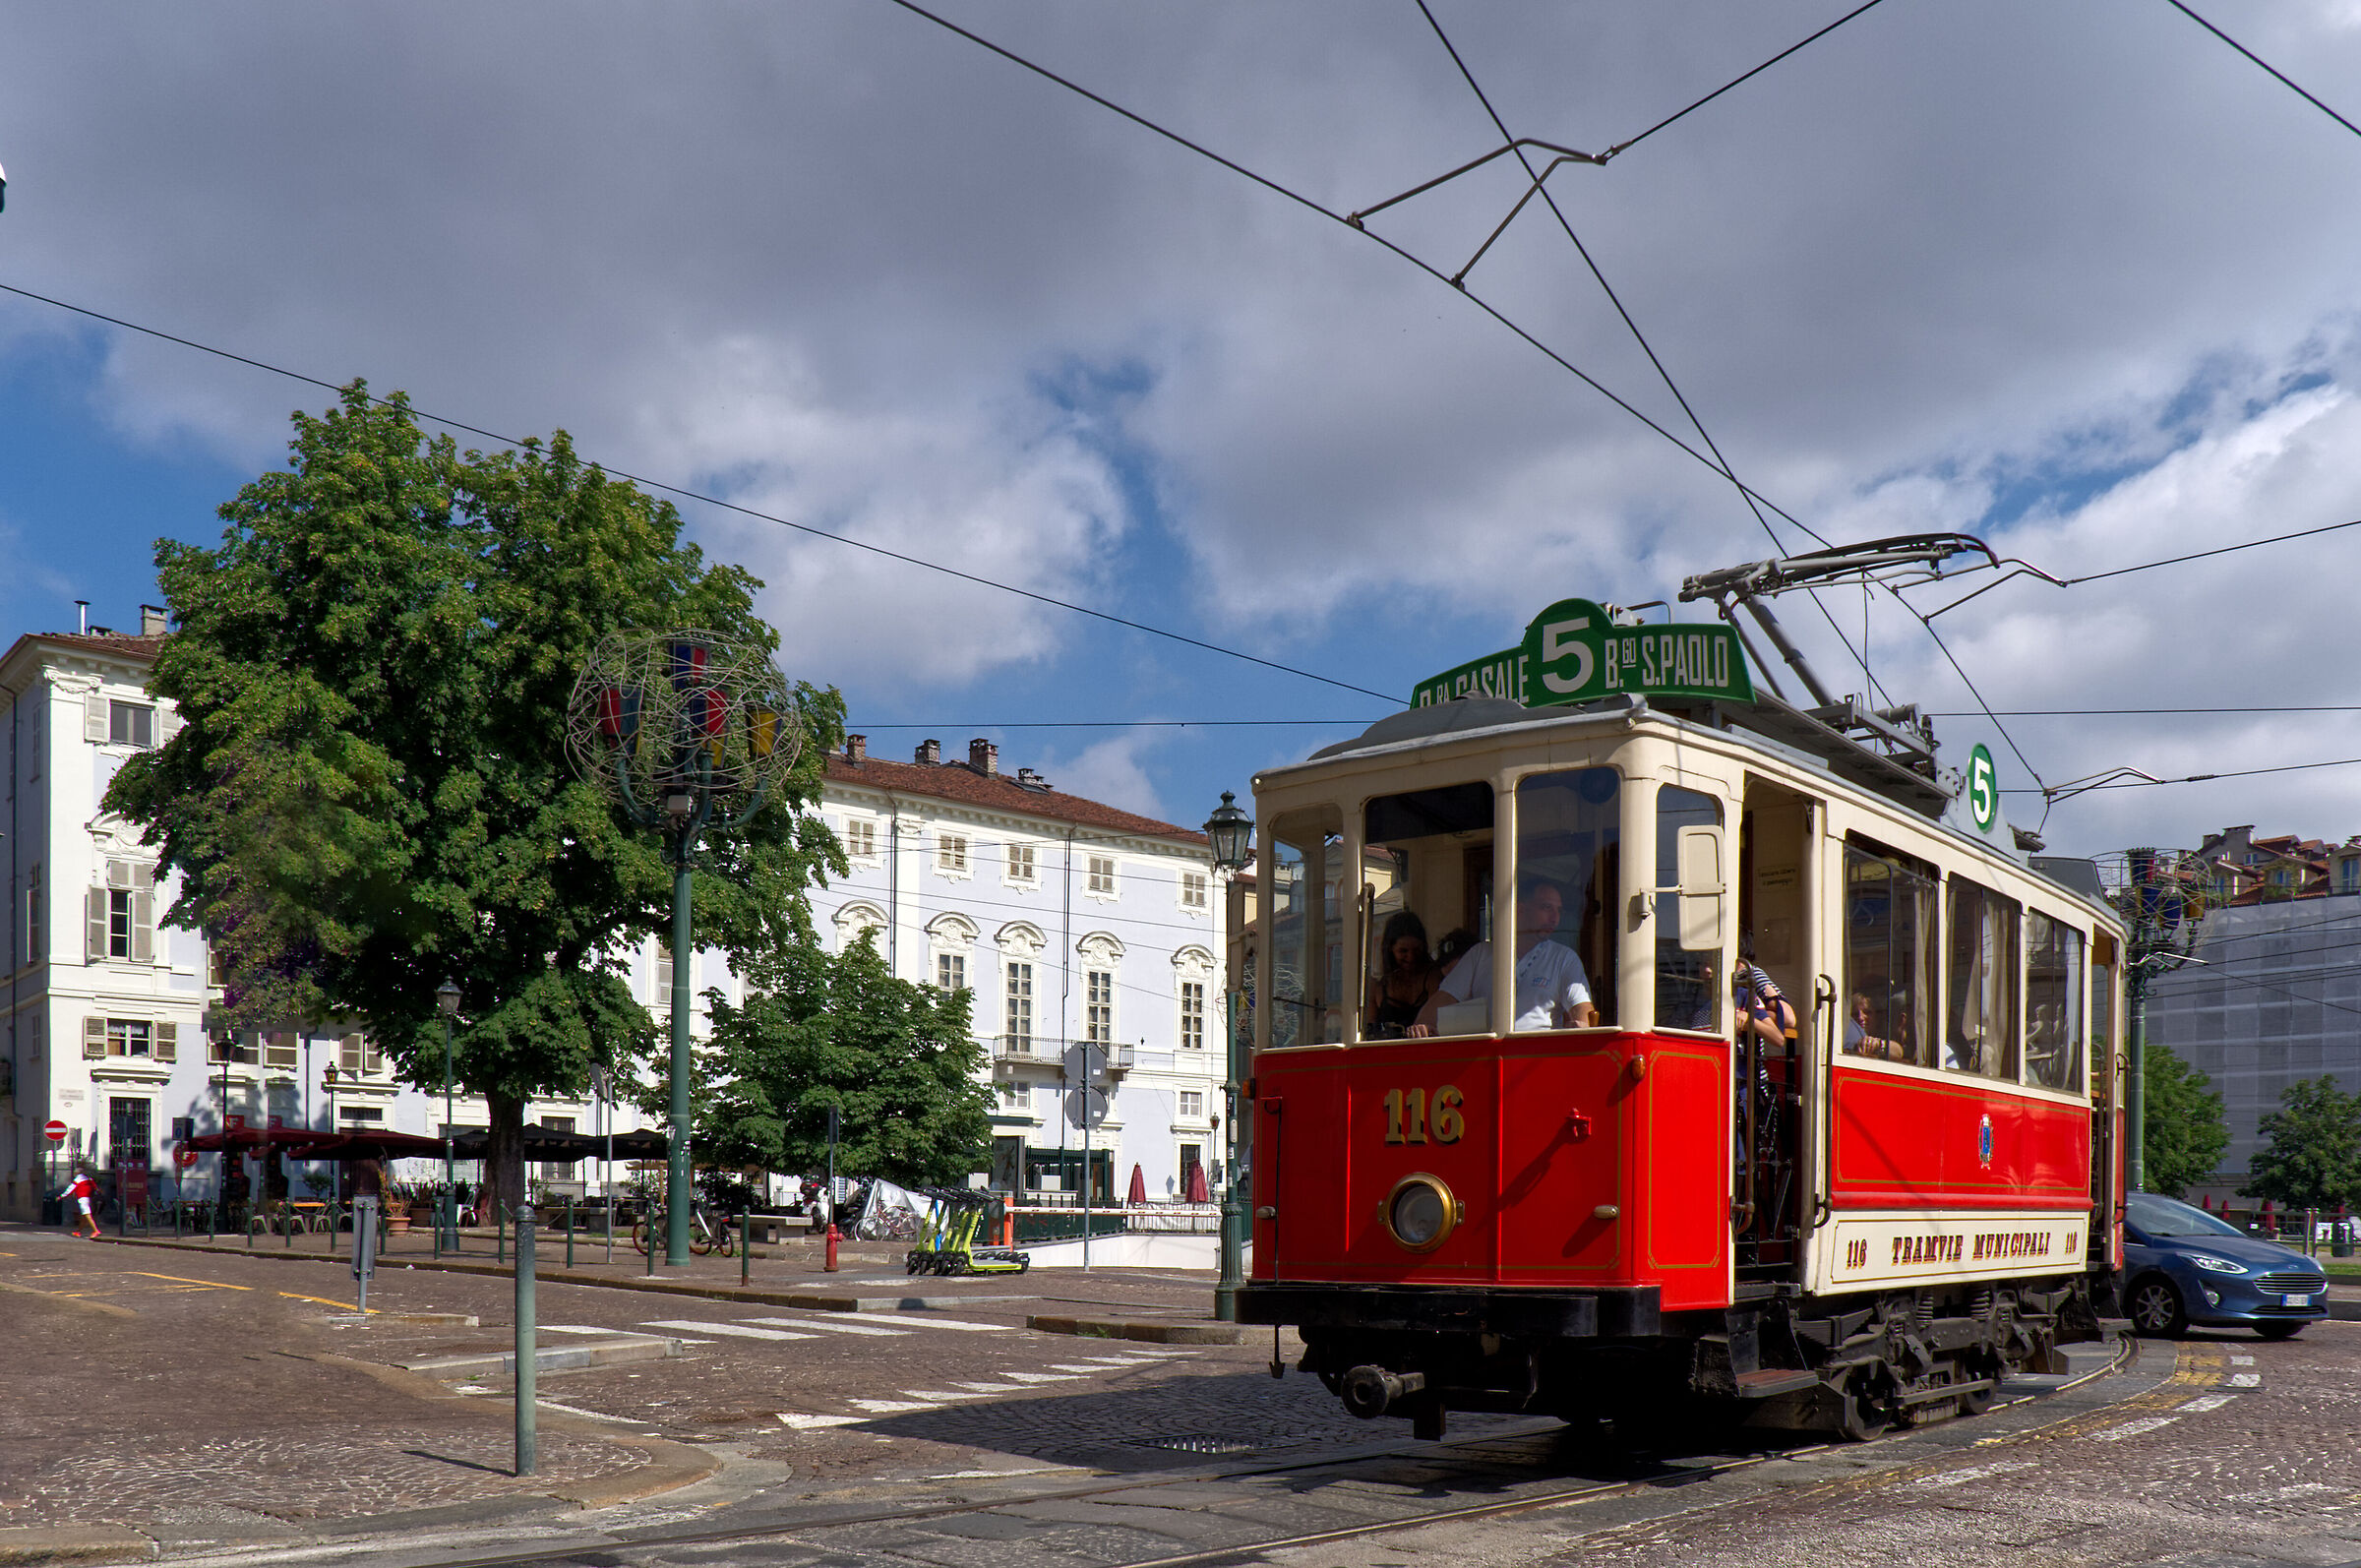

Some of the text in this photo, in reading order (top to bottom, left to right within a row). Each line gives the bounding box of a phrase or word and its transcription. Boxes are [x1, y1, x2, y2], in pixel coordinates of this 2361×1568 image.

[1542, 617, 1595, 694] 5
[1973, 756, 1990, 823] 5
[1383, 1084, 1465, 1145] 116
[1846, 1238, 1867, 1269] 116
[1891, 1235, 1964, 1266] TRAMVIE
[1972, 1232, 2050, 1260] MUNICIPALI
